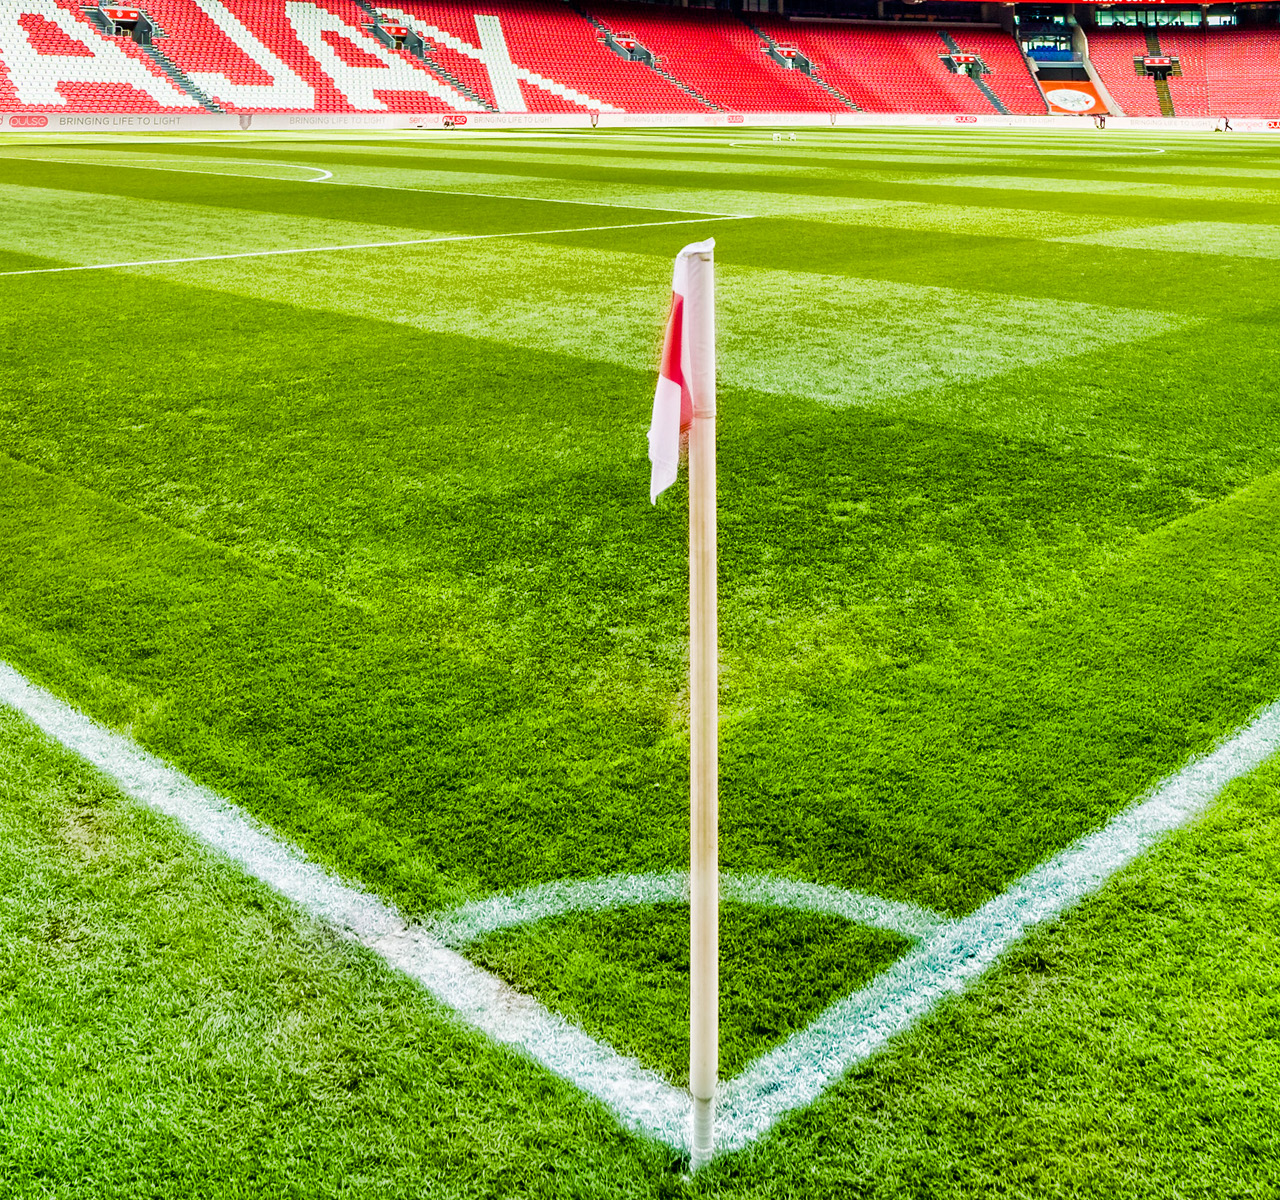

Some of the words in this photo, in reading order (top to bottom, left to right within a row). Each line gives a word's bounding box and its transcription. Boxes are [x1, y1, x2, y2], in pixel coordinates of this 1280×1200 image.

[10, 116, 47, 128] pulse
[59, 117, 110, 126] BRINGING
[113, 117, 134, 126] LIFE
[138, 117, 151, 126] TO
[154, 117, 181, 126] LIGHT
[289, 116, 329, 124] BRINGING
[331, 116, 348, 124] LIFE
[350, 116, 362, 124] TO
[364, 116, 386, 124] LIGHT
